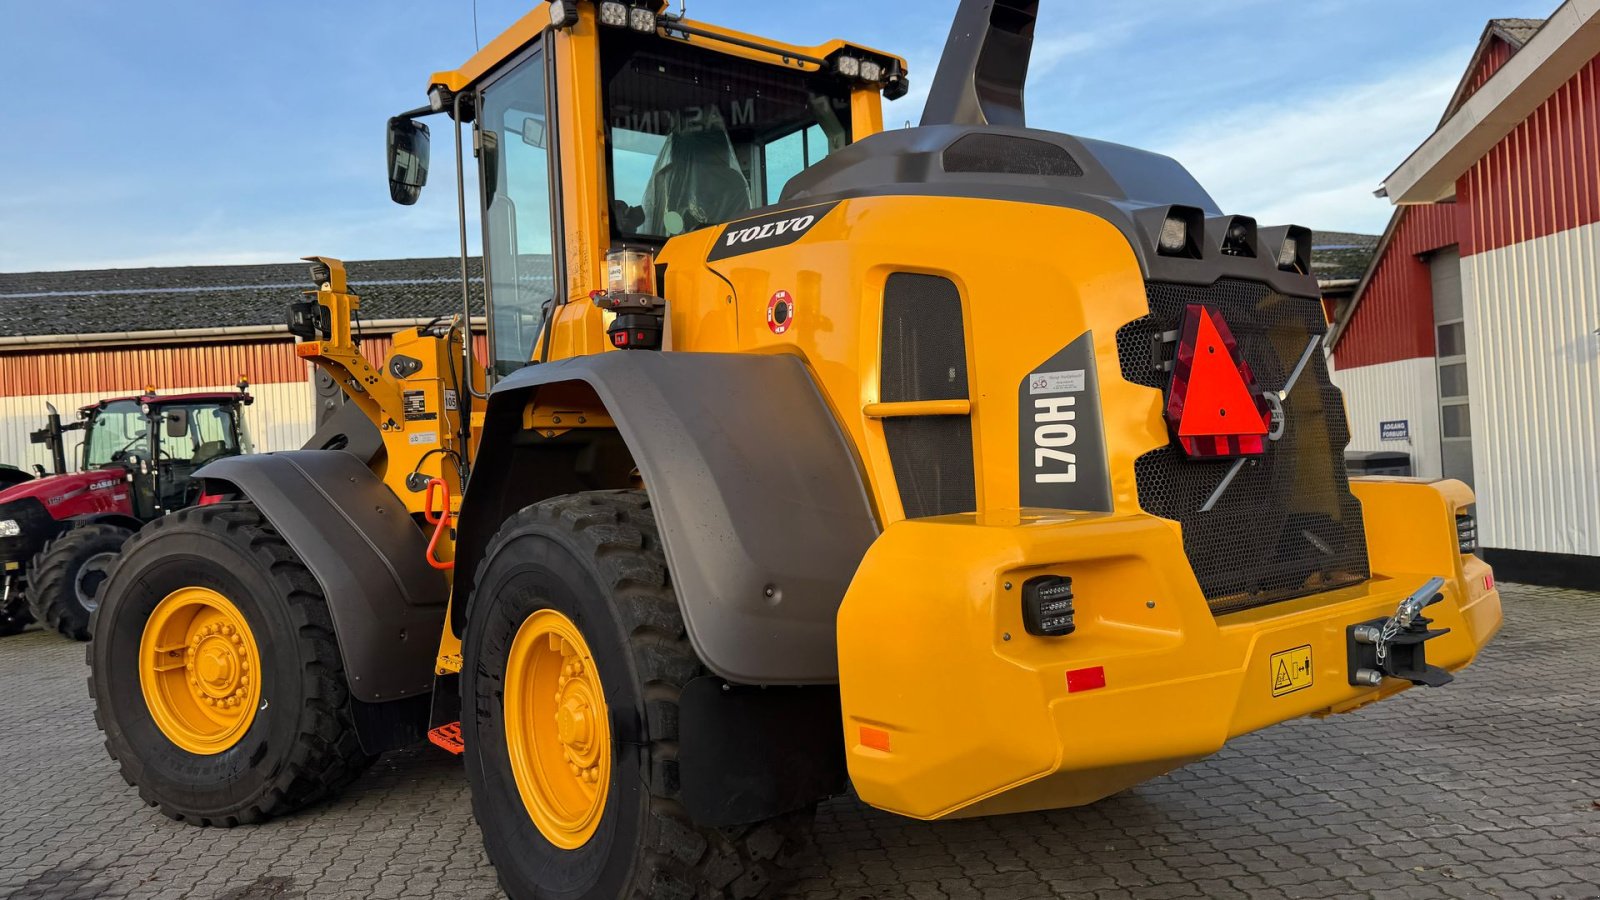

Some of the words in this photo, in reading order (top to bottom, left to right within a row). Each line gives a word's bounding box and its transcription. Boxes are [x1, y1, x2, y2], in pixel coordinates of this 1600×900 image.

[726, 215, 814, 246] VOLVO
[1382, 430, 1407, 438] FORBUDT
[1383, 422, 1405, 430] ADGANG
[1034, 396, 1076, 483] L70H
